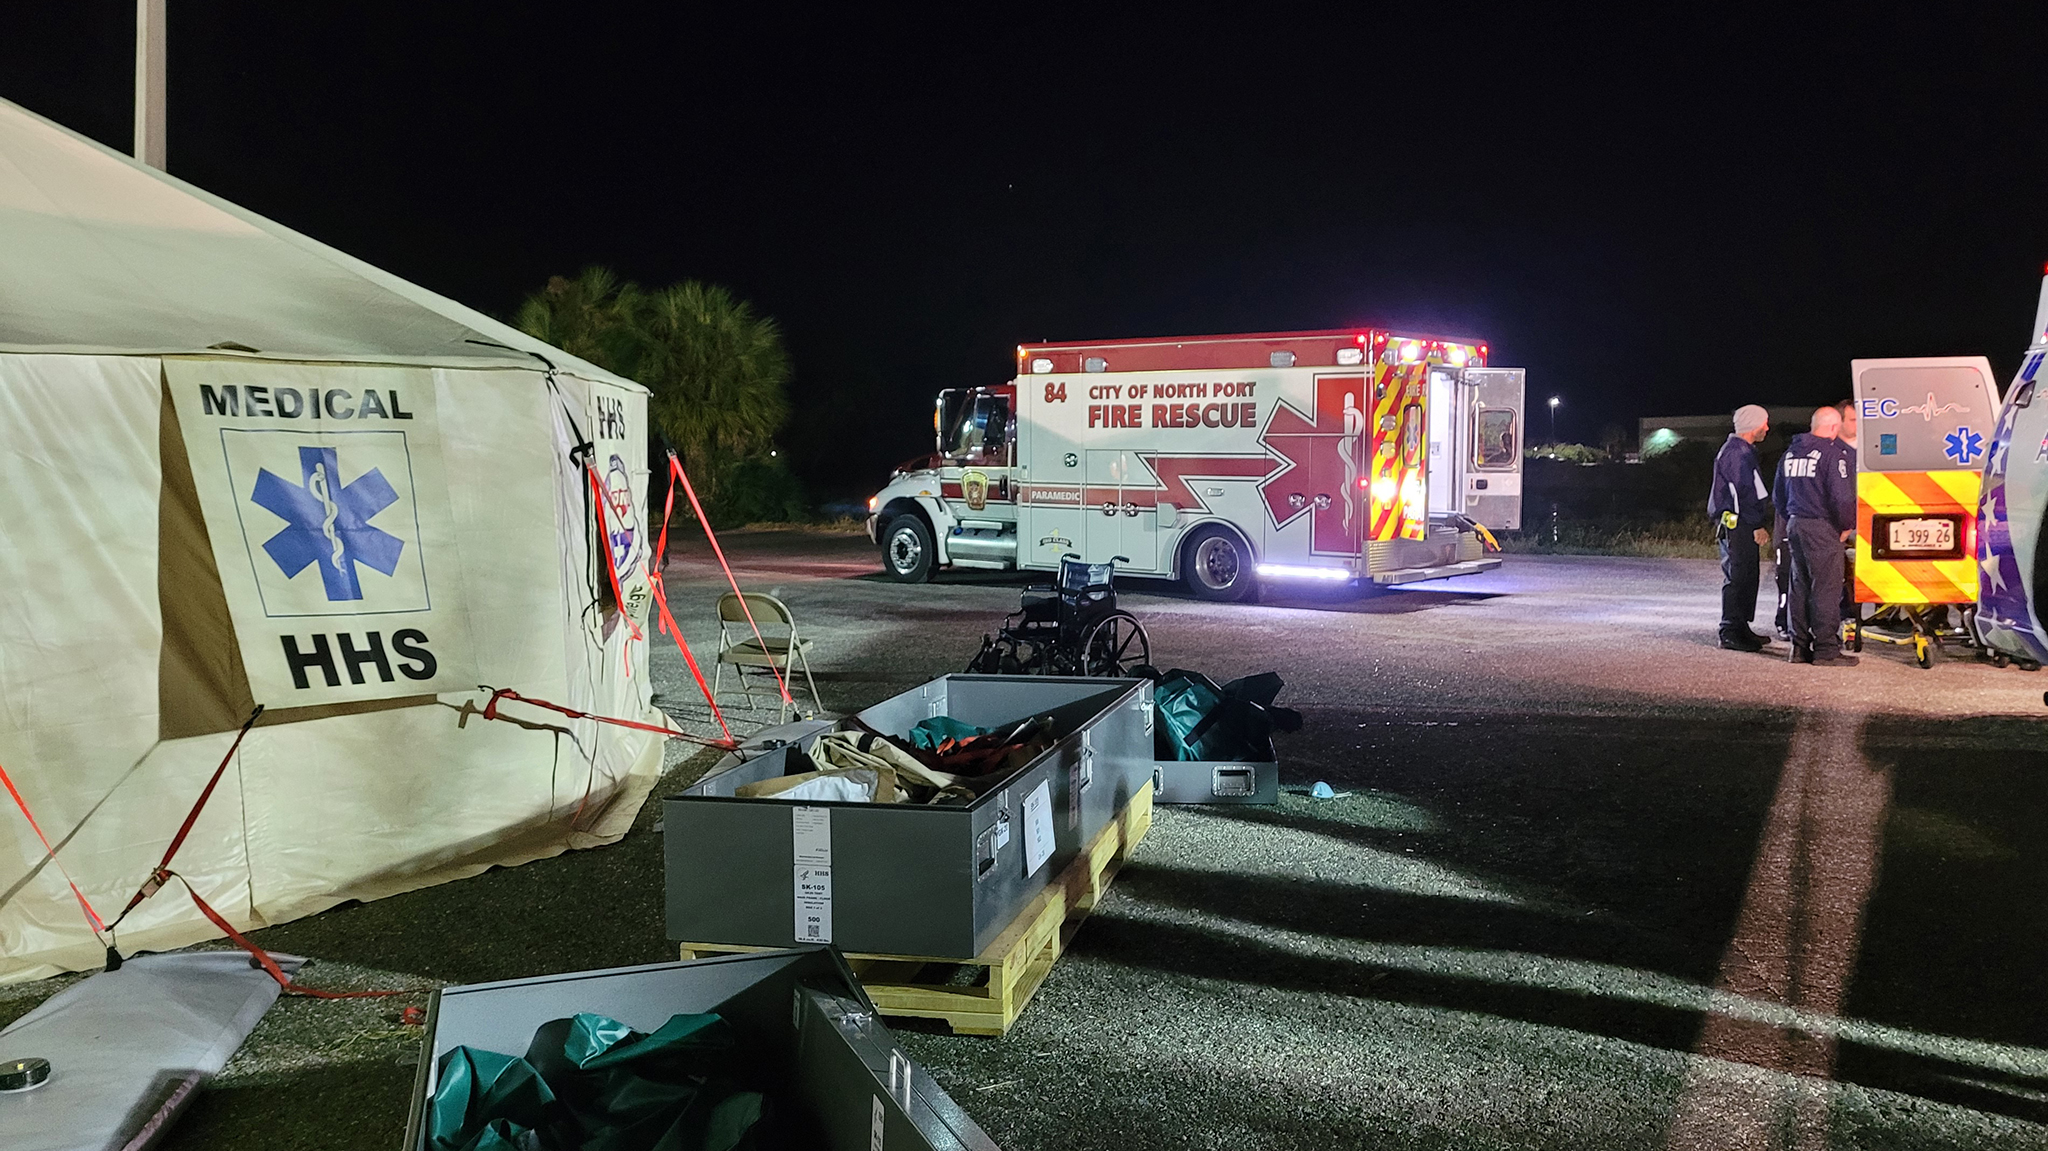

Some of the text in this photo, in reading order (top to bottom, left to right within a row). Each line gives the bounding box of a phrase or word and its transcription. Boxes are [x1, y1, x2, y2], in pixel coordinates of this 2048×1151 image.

[1044, 382, 1067, 403] 84
[1089, 381, 1257, 400] CITY OF NORTH PORT
[199, 384, 413, 420] MEDICAL
[597, 396, 625, 440] HHS
[1088, 402, 1257, 428] FIRE RESCUE
[1784, 458, 1818, 478] FIRE
[1031, 490, 1080, 501] PARAMEDIC
[1893, 528, 1951, 544] 1 399 26
[279, 628, 438, 690] HHS
